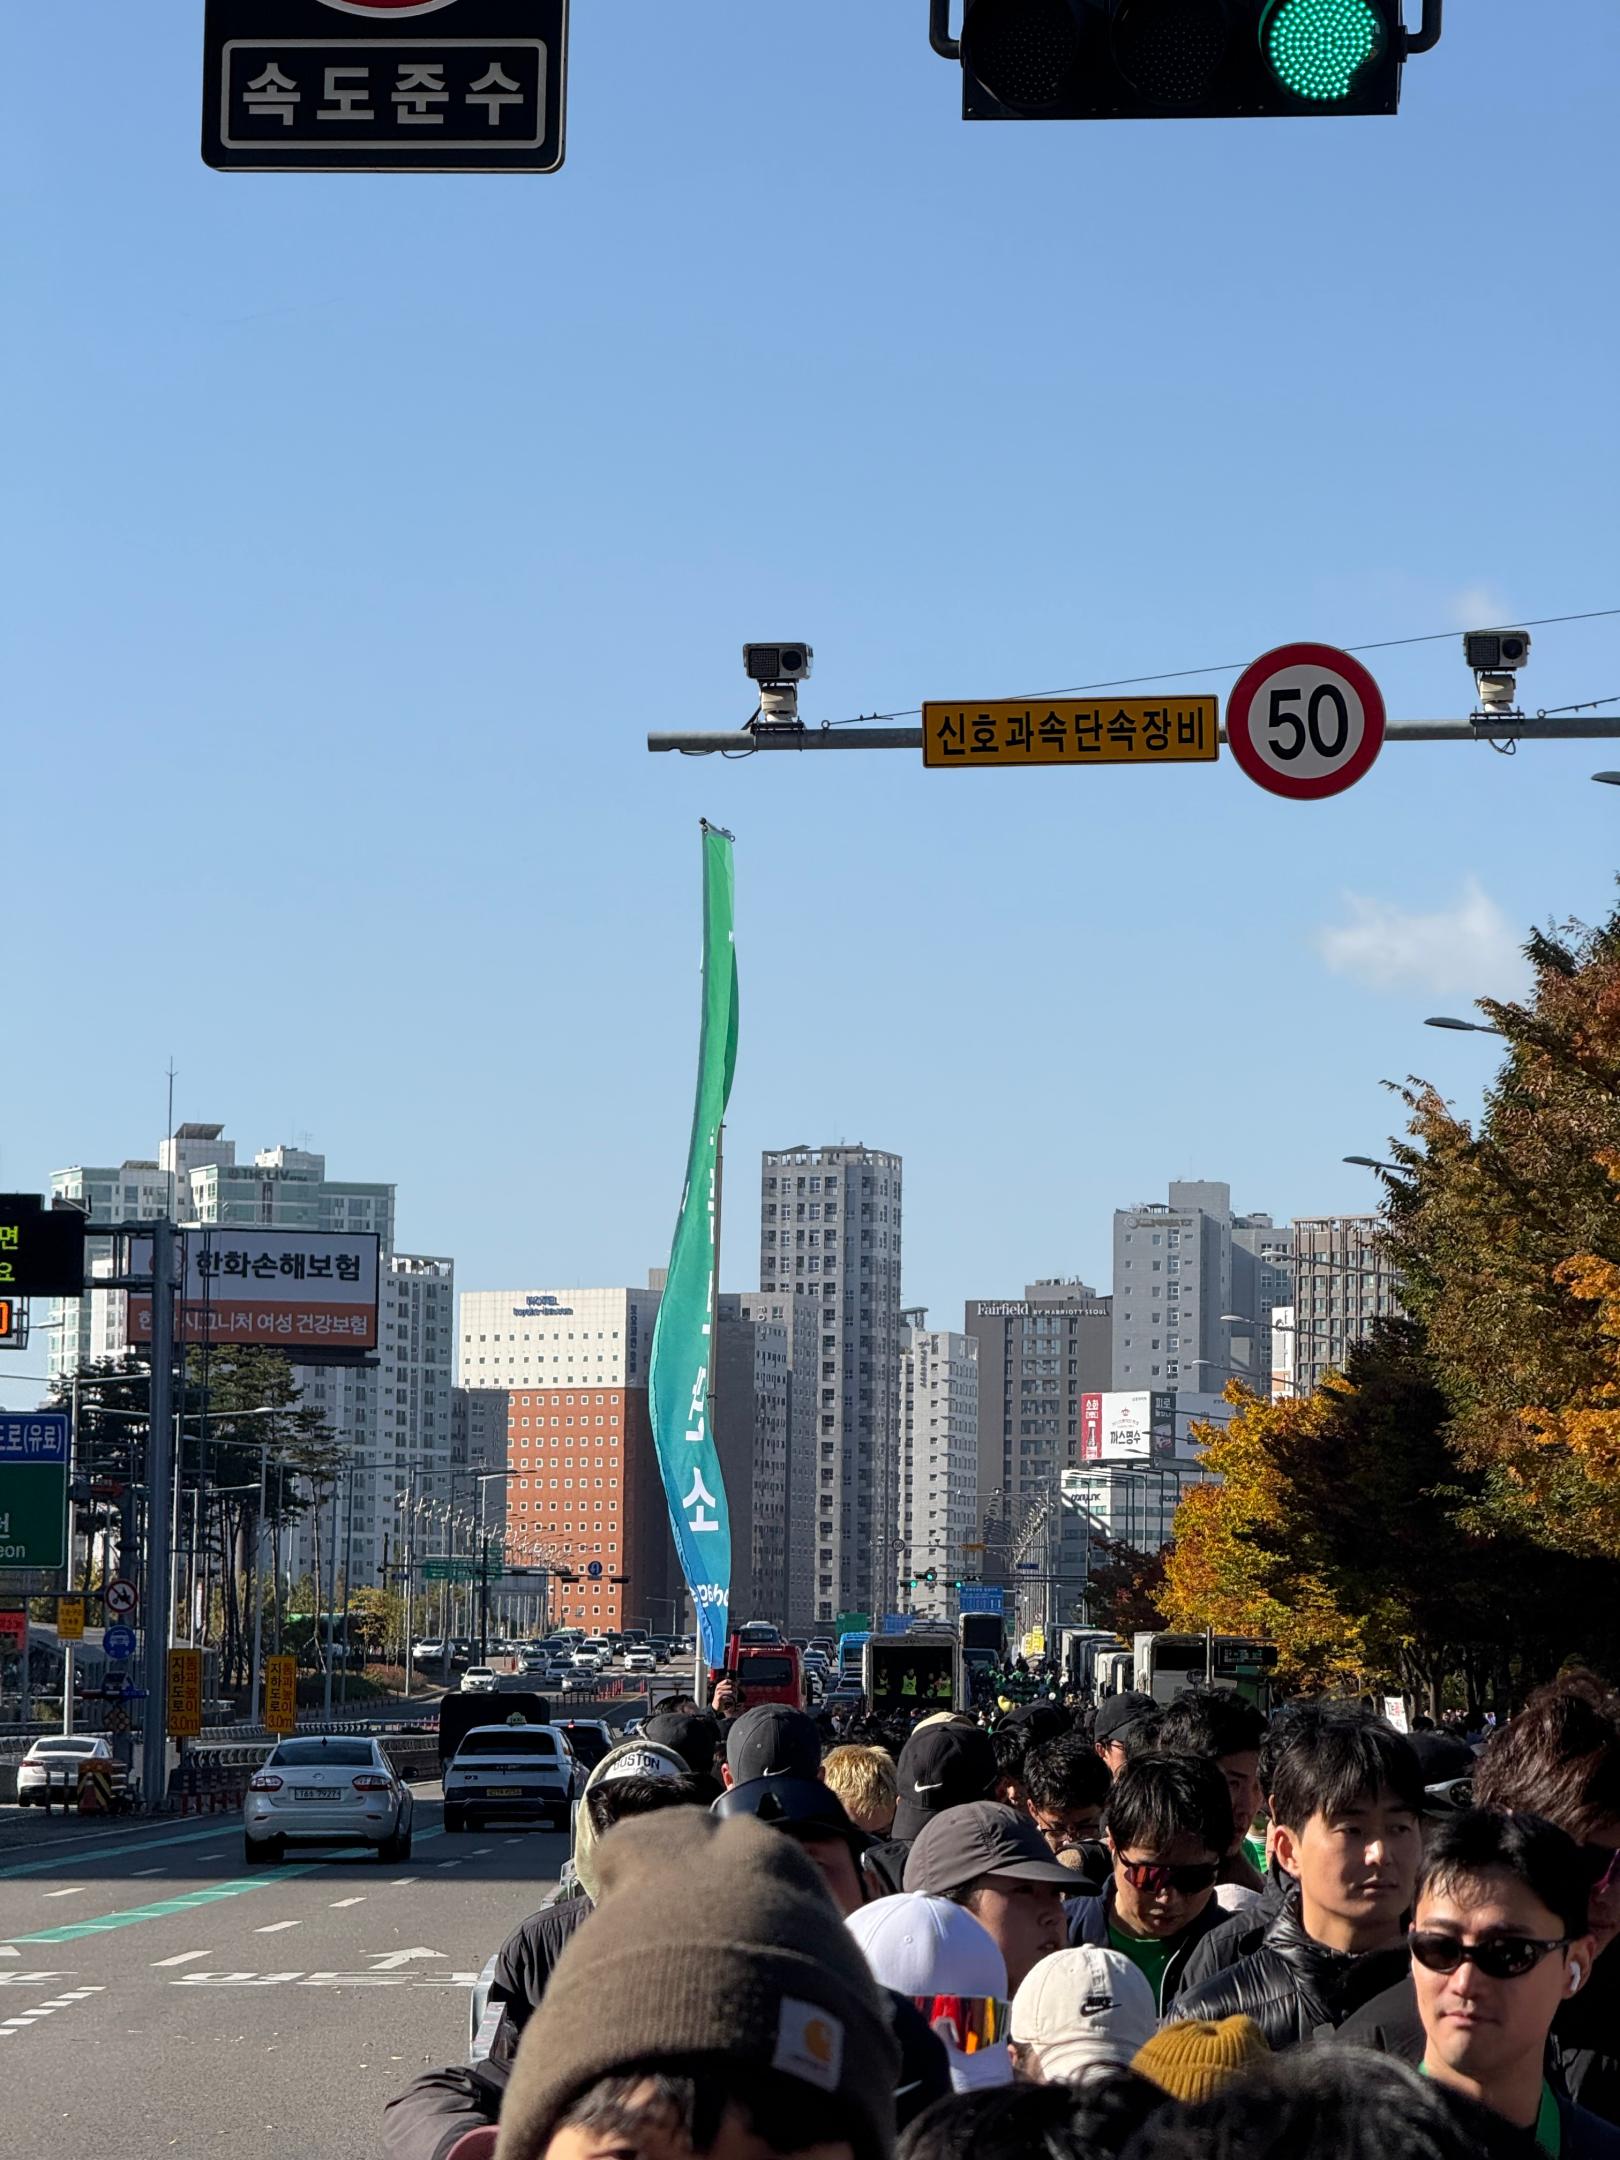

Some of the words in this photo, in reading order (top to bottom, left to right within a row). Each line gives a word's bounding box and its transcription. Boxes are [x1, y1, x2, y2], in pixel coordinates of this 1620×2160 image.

[242, 62, 525, 126] 속도준수
[936, 706, 1204, 756] 신호과속단속장비
[1268, 683, 1348, 761] 50
[195, 1251, 361, 1281] 한화손해보험
[257, 1313, 292, 1334] 여성
[296, 1314, 368, 1335] 건강보험
[977, 1302, 1029, 1316] Fairfield
[0, 1424, 62, 1454] 로(유료)
[172, 1656, 185, 1712] 지하도로
[269, 1663, 281, 1712] 지하도로
[170, 1715, 198, 1731] 3.0m
[268, 1715, 293, 1729] 3.0m
[1087, 1996, 1112, 2007] NIKE
